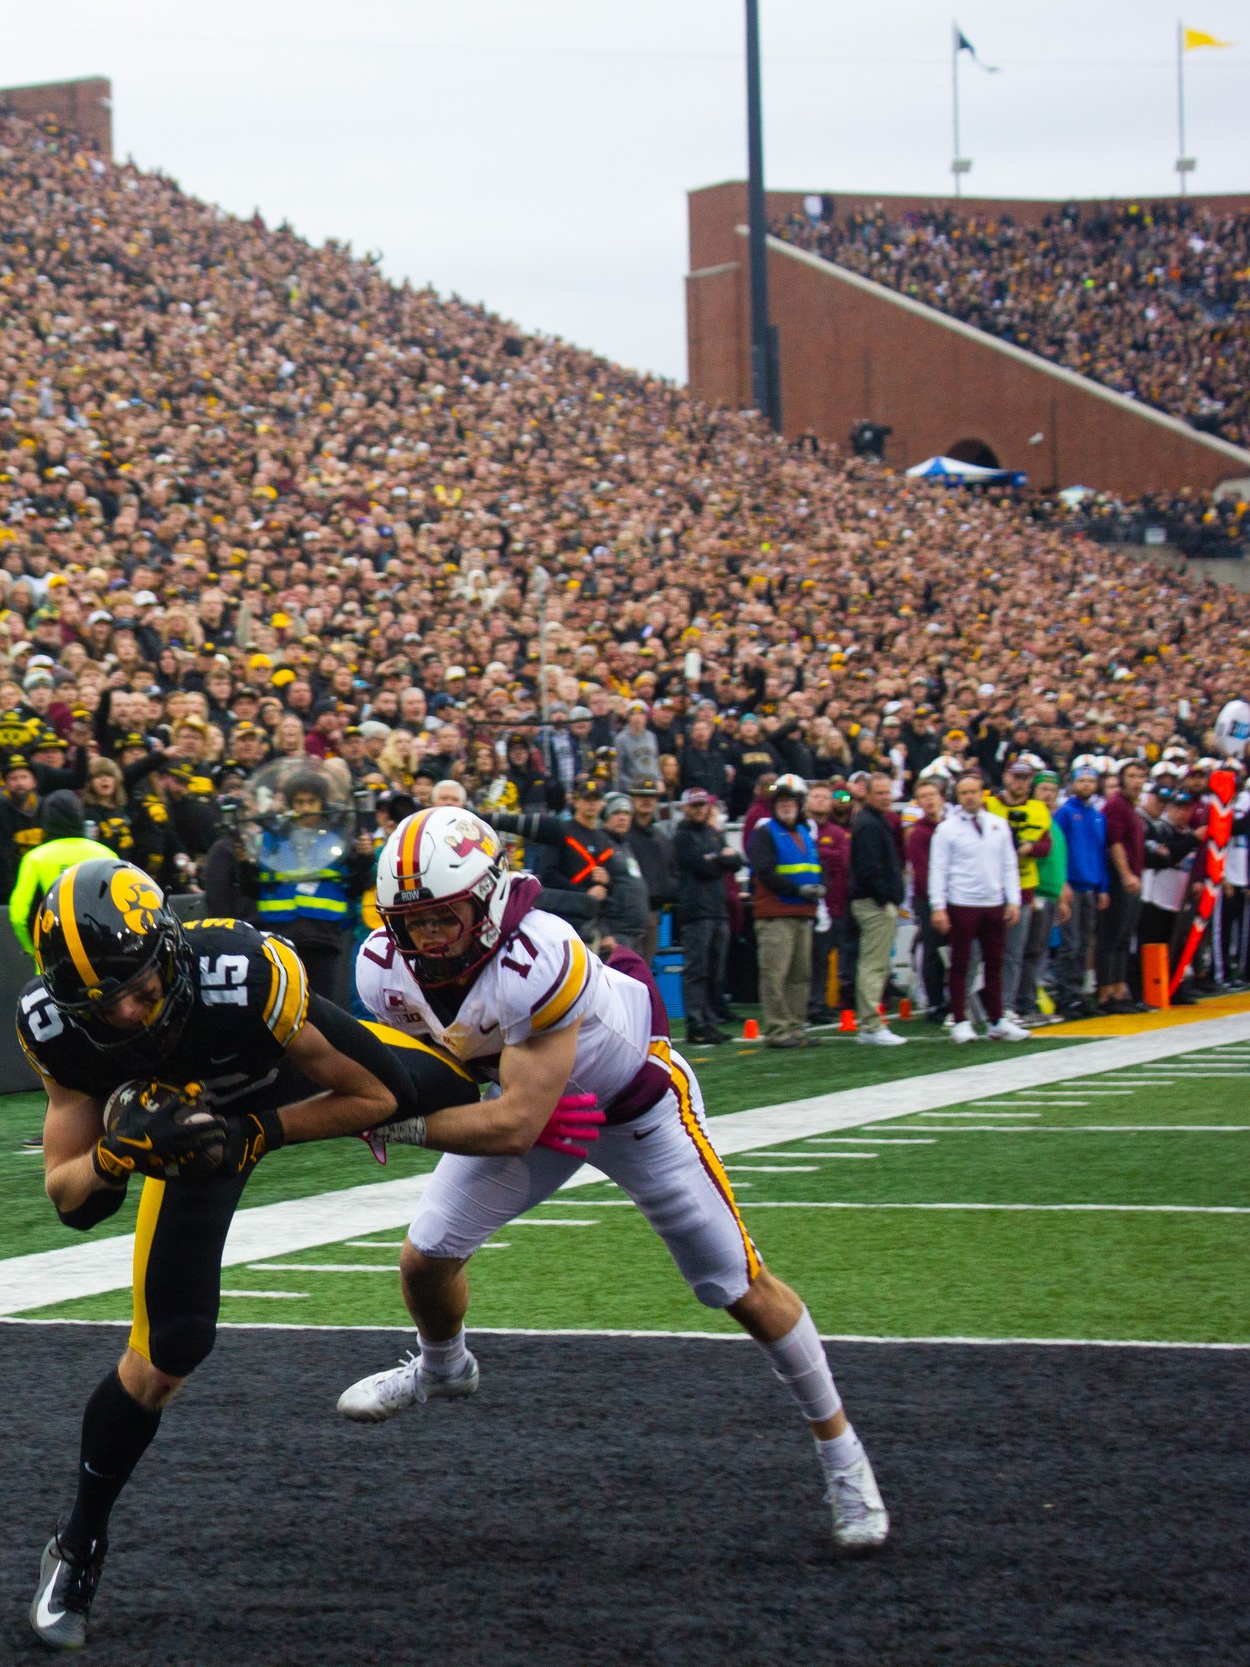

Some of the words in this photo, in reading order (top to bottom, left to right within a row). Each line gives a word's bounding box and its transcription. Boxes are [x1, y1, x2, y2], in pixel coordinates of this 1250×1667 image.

[401, 889, 420, 901] ROW
[200, 953, 250, 1007] 15
[501, 933, 539, 980] 17
[21, 987, 64, 1043] 15
